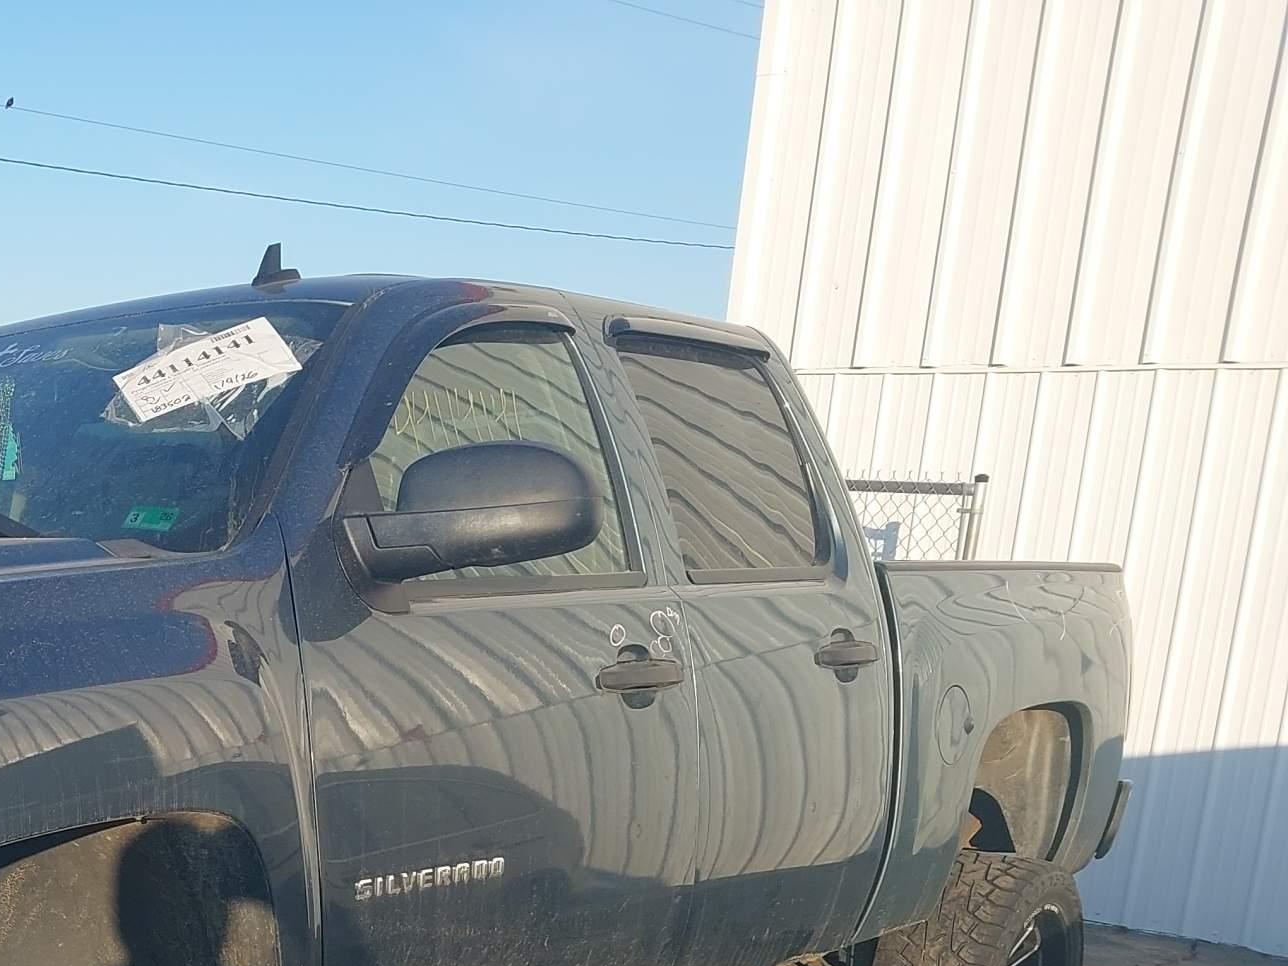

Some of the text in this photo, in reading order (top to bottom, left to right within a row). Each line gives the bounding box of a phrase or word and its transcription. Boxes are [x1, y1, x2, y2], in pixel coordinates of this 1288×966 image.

[137, 334, 255, 386] 44114141
[129, 511, 140, 523] 3
[354, 857, 505, 901] SILVERADO
